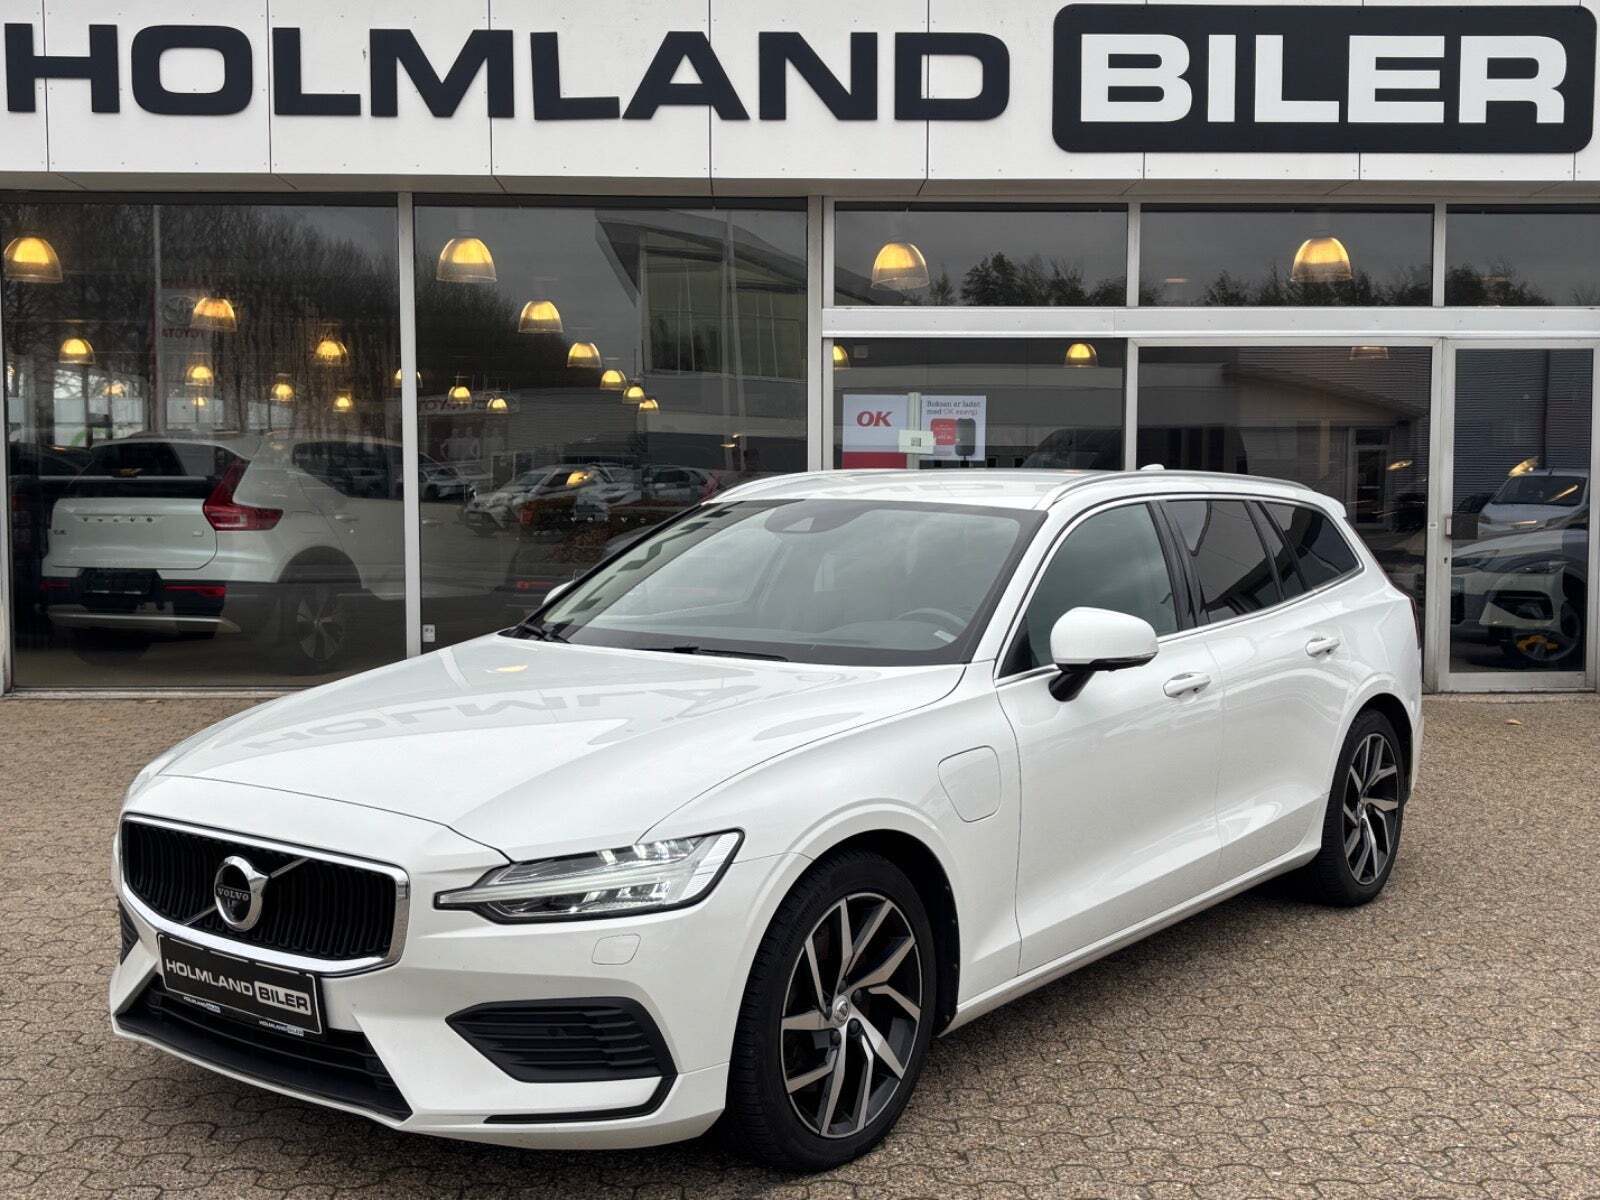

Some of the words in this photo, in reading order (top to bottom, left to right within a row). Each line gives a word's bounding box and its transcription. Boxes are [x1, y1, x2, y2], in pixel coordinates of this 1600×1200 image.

[5, 24, 1010, 121] HOLMLAND
[1079, 33, 1567, 124] BILER
[857, 411, 893, 427] OK
[217, 888, 249, 901] VOLVO
[166, 958, 253, 996] HOLMLAND
[258, 986, 309, 1011] BILER
